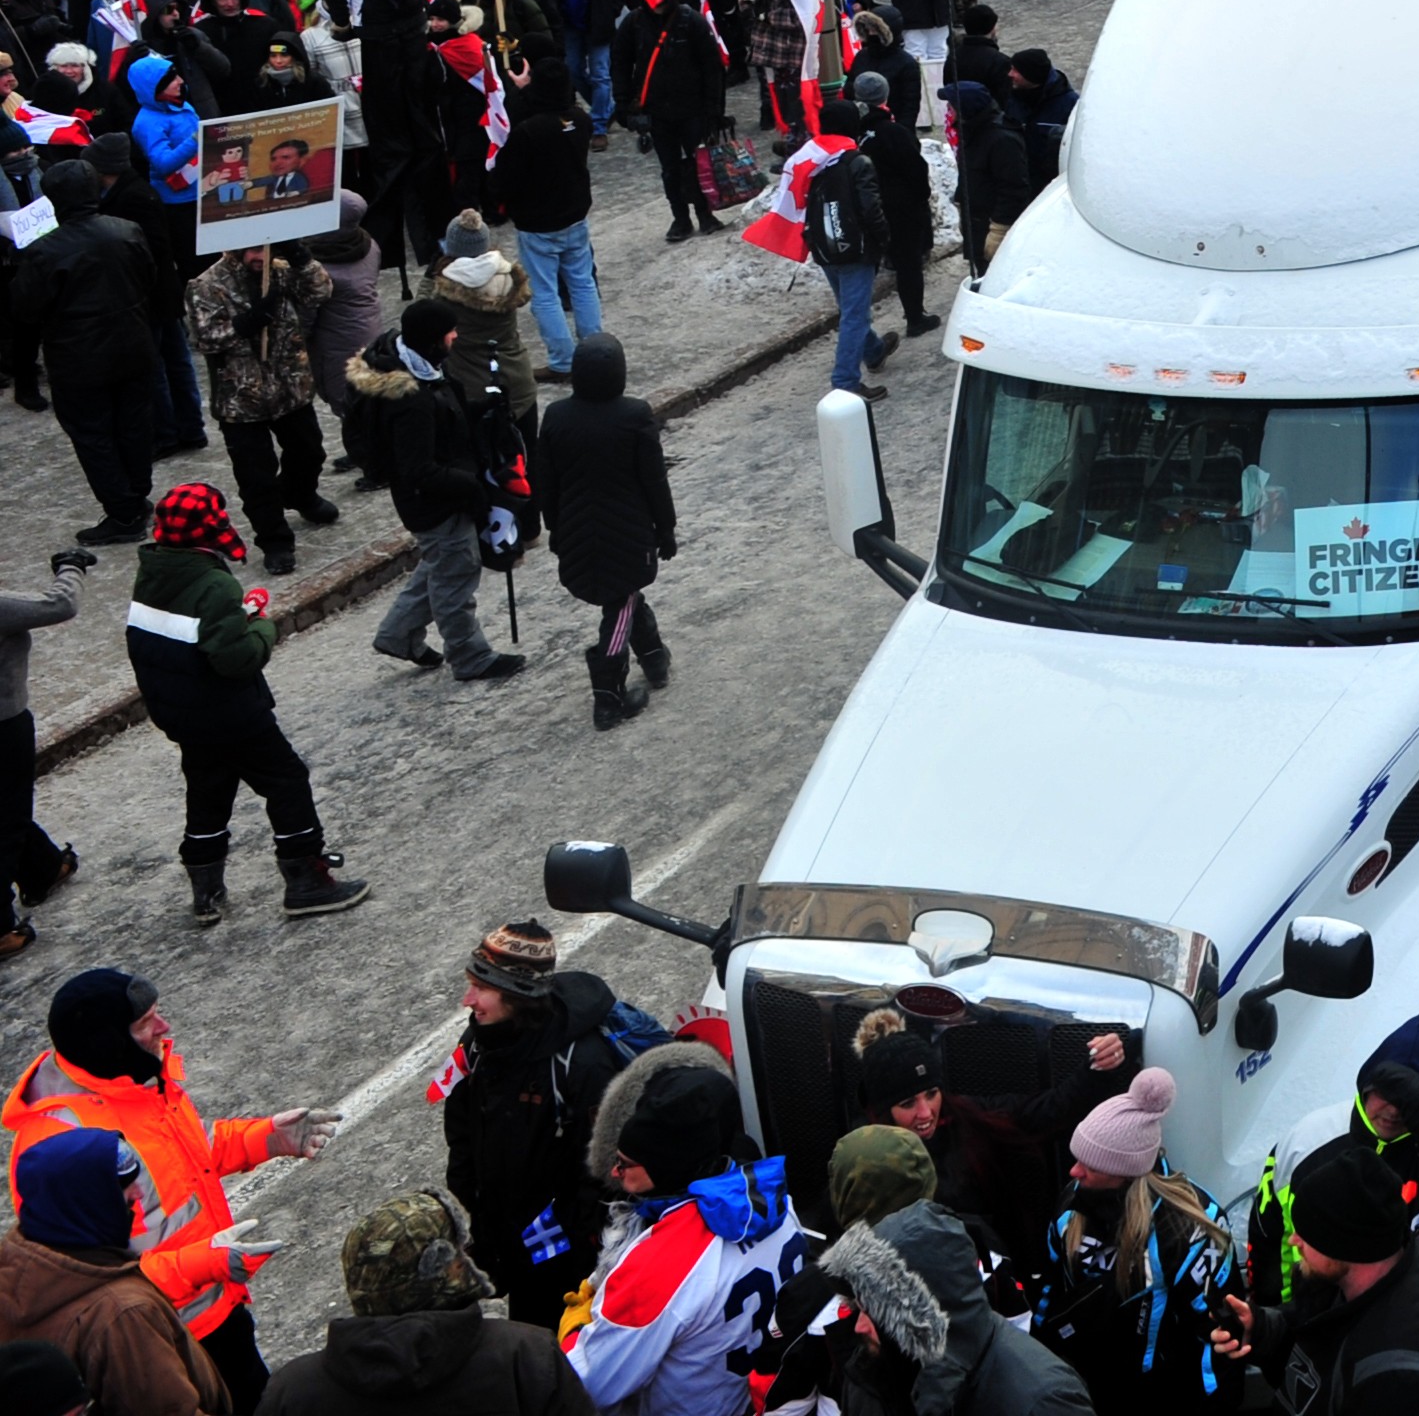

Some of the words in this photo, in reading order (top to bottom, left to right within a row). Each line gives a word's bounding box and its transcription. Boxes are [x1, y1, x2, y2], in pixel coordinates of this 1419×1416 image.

[287, 113, 303, 122] the
[257, 128, 276, 136] hurt
[278, 125, 295, 134] you
